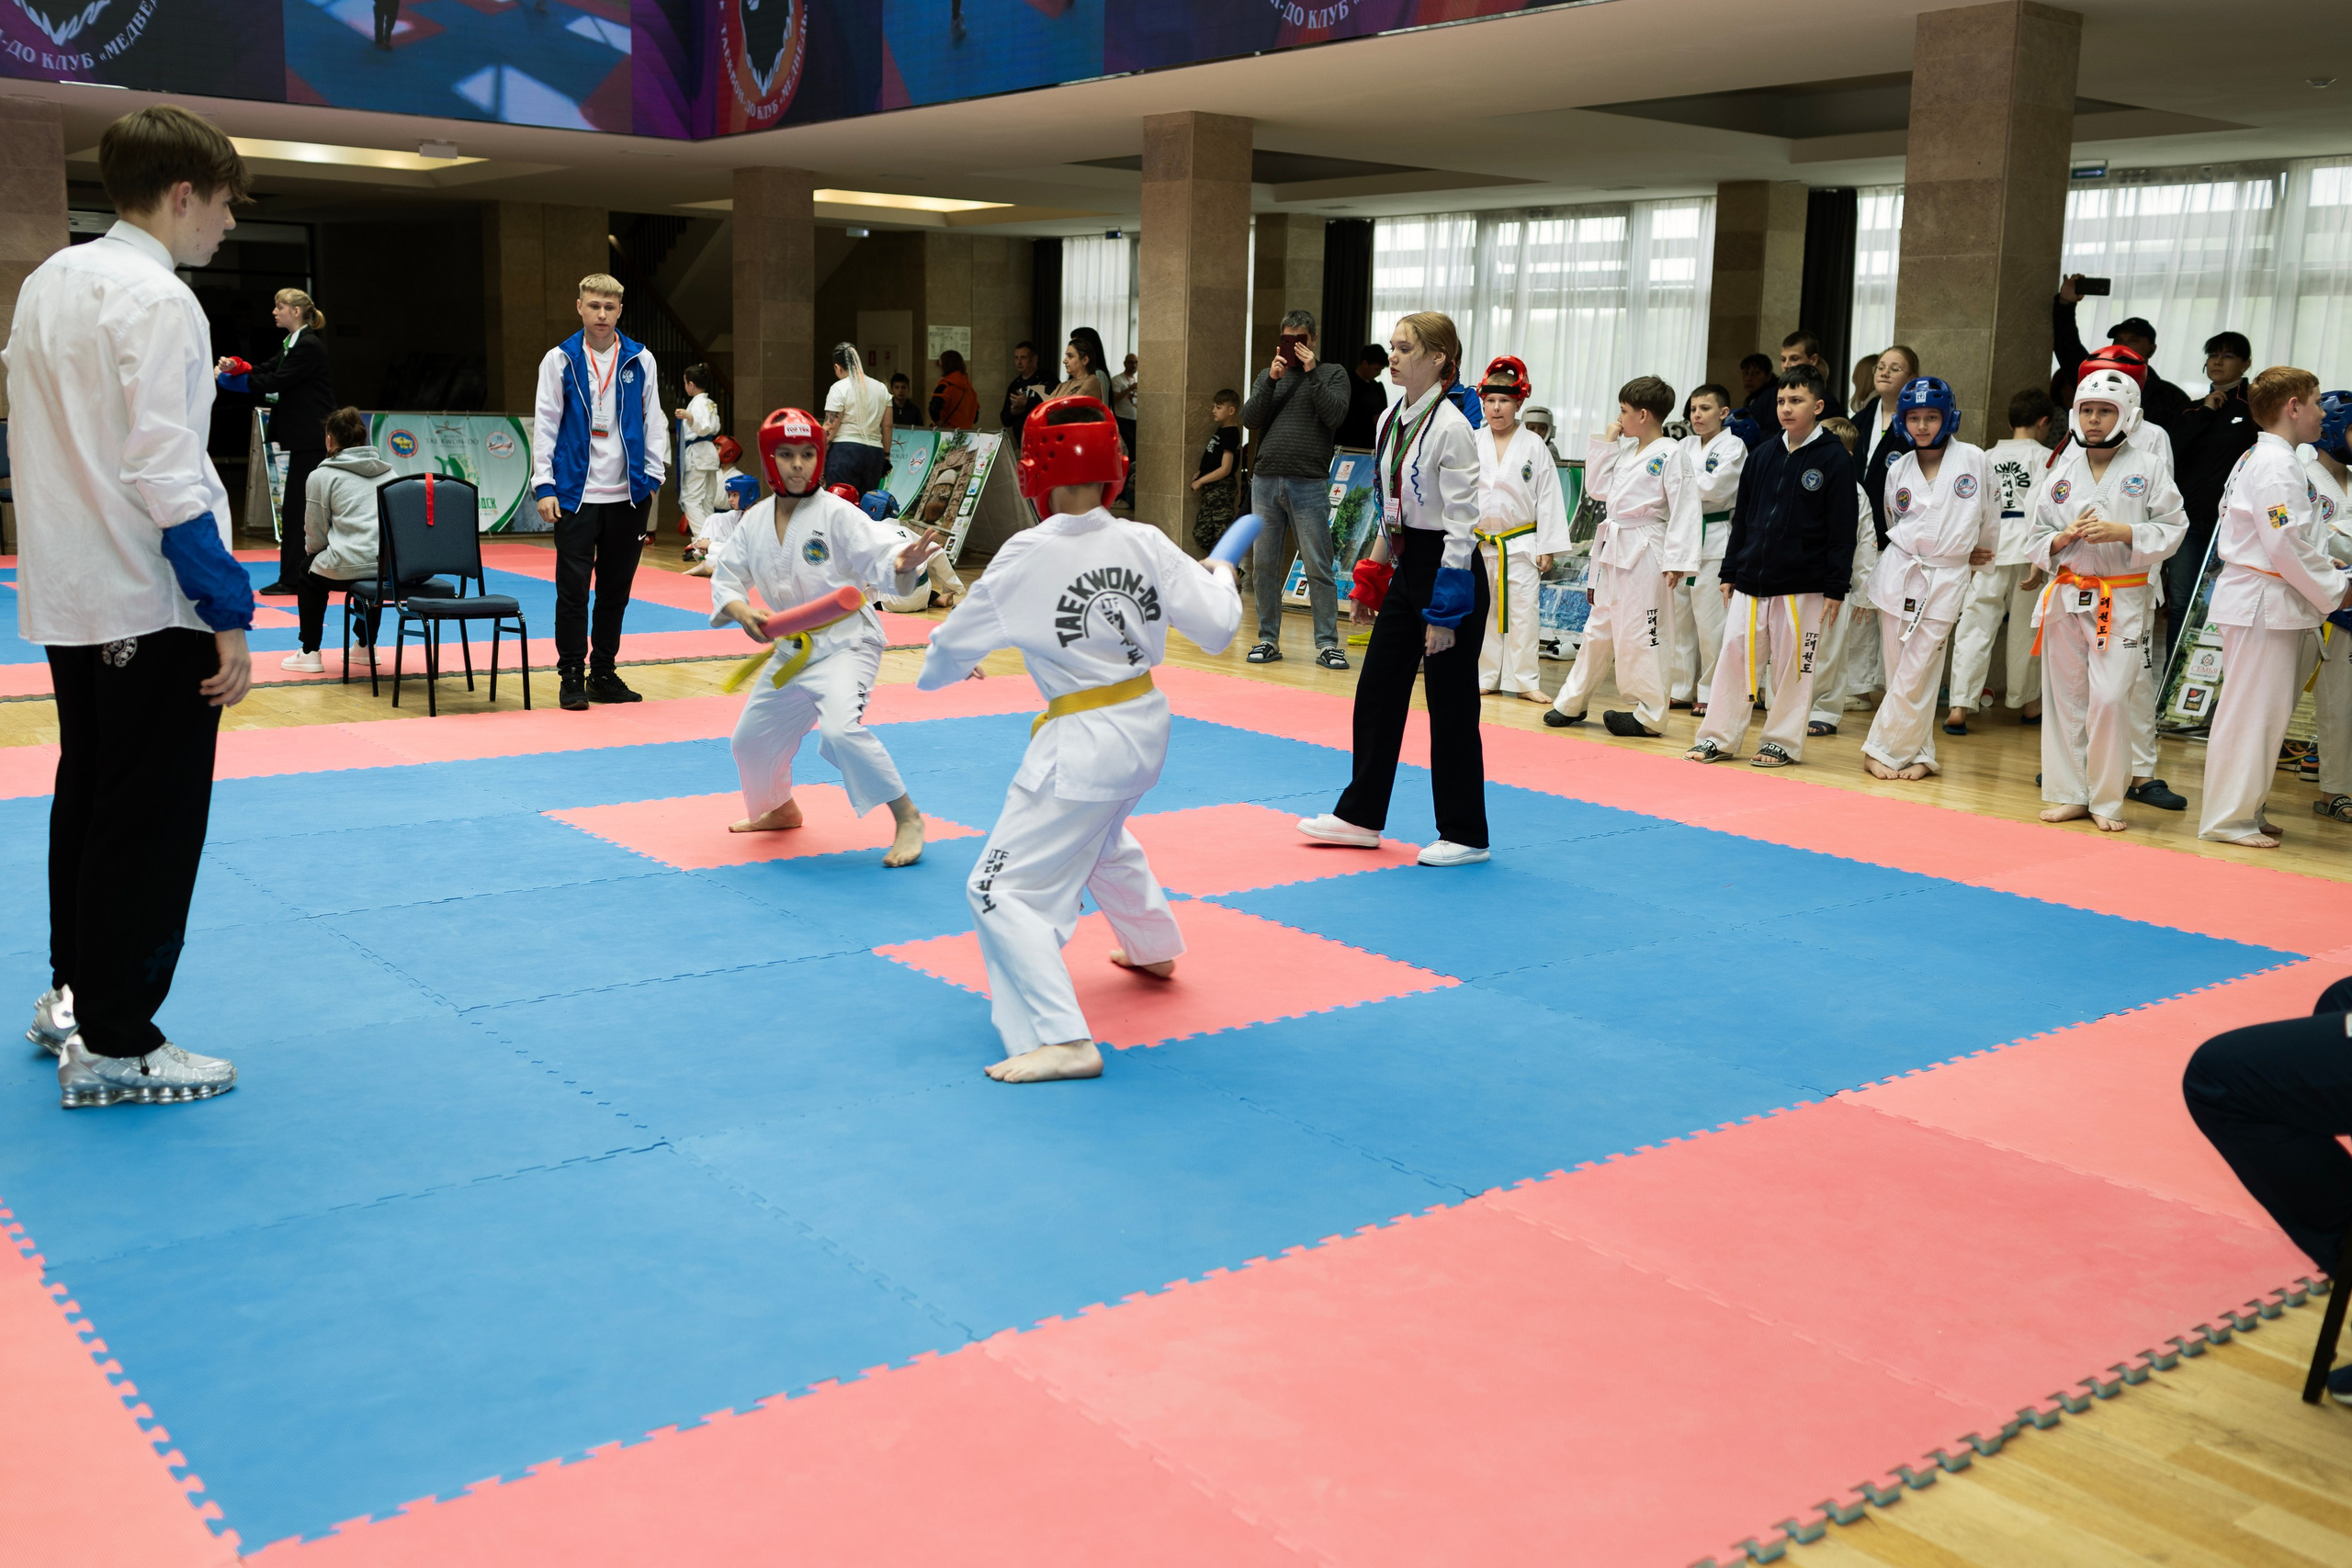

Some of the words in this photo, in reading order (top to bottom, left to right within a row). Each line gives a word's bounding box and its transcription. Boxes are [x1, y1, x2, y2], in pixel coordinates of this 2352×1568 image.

[1307, 2, 1349, 28] КЛУБ
[0, 28, 37, 62] -ДО
[41, 52, 95, 71] КЛУБ
[1055, 567, 1161, 649] TAEKWON-DO
[2097, 597, 2110, 635] 태권도
[1800, 638, 1816, 673] 태권도
[2191, 666, 2218, 674] СЕМЬЯ
[989, 849, 1010, 860] ITF
